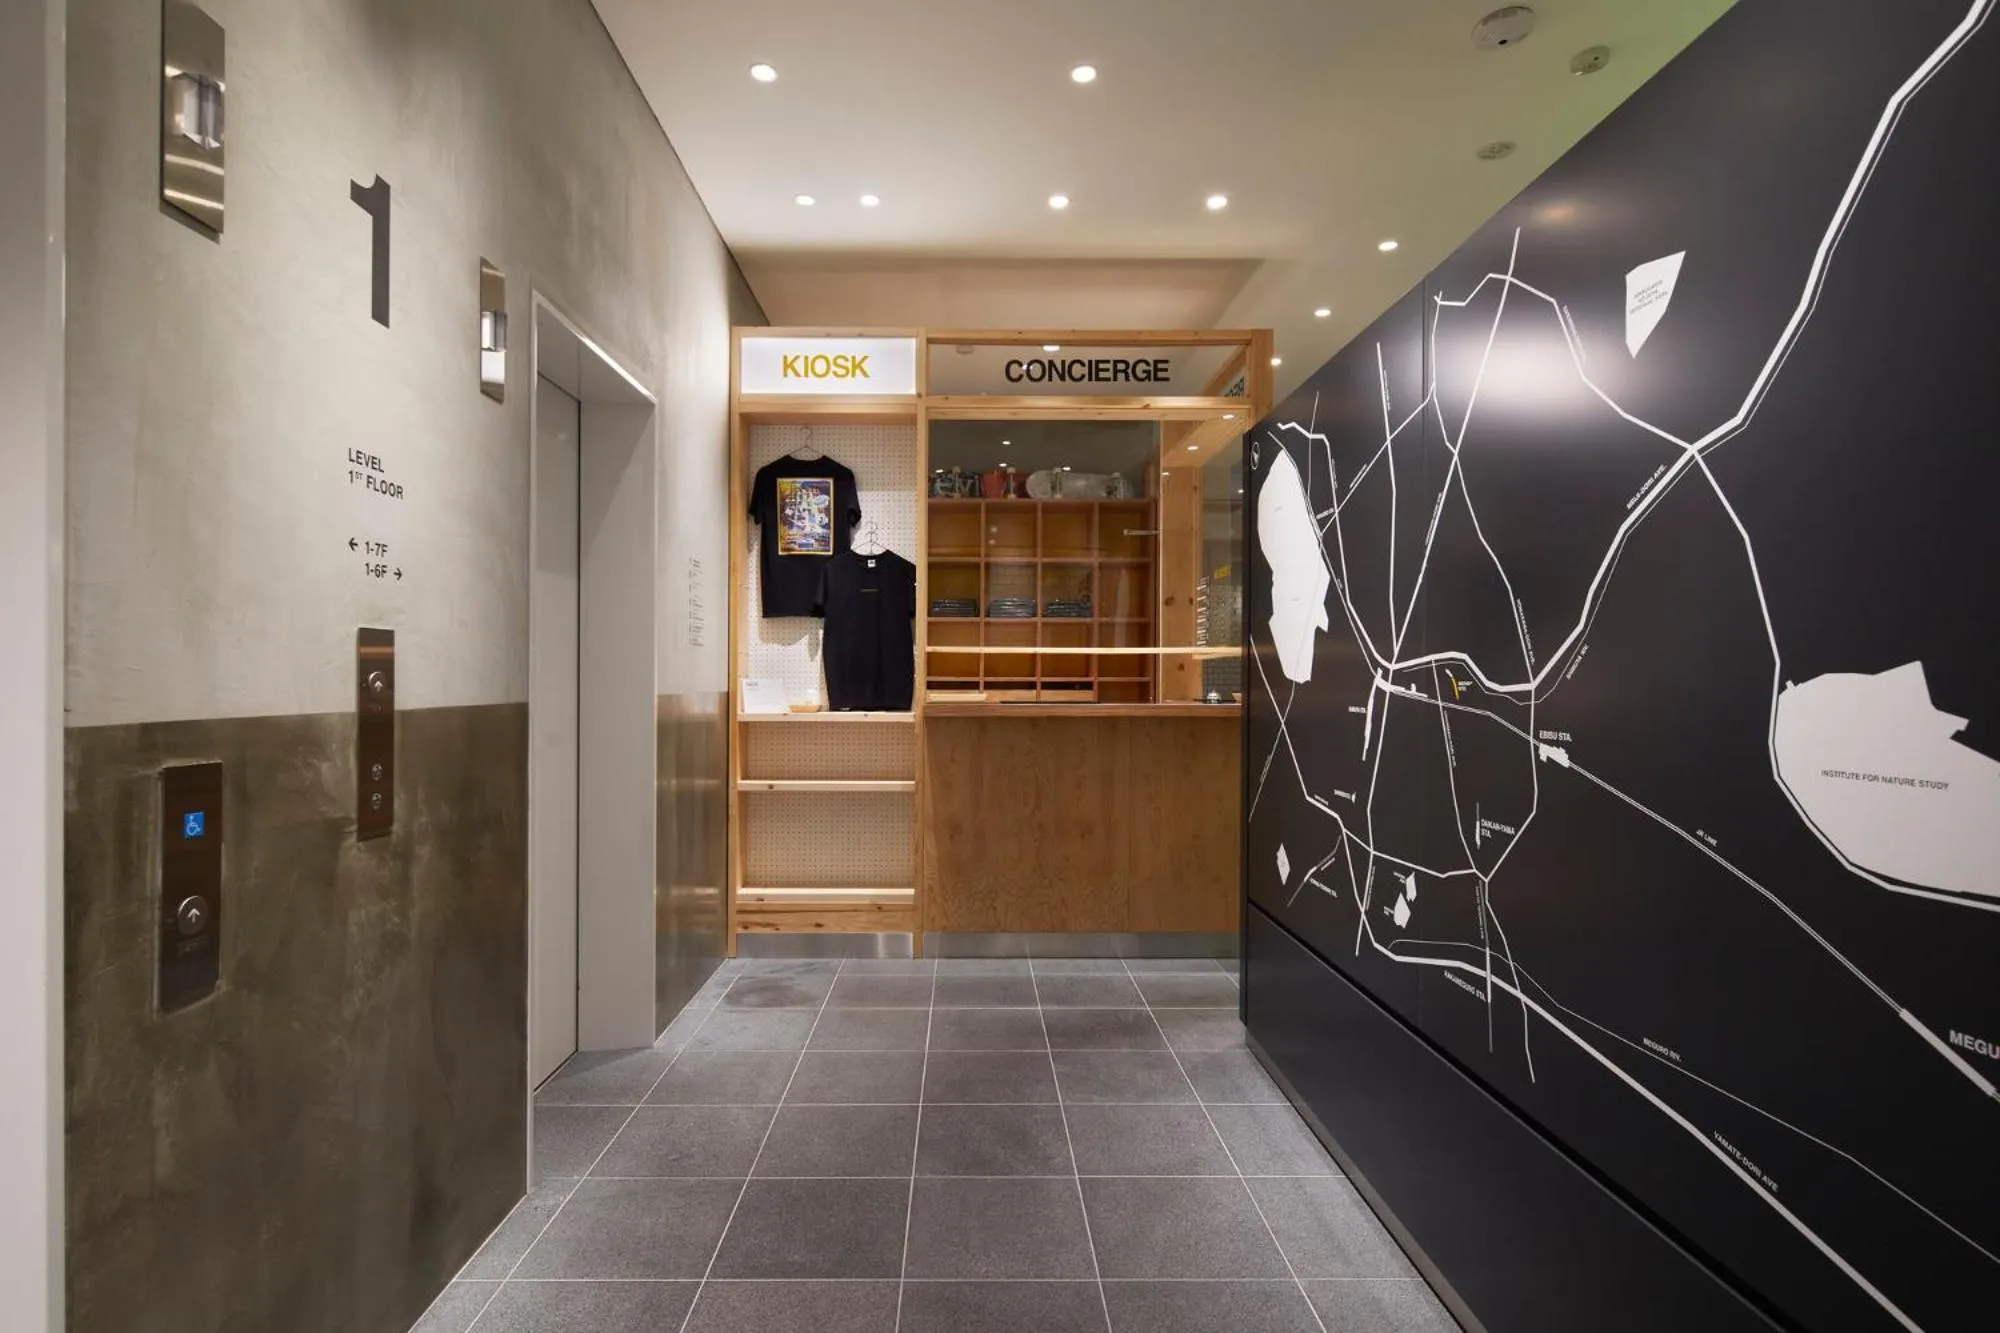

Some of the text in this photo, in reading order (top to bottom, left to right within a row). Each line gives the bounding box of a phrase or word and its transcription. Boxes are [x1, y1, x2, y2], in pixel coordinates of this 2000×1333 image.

[350, 173, 391, 329] 1
[782, 354, 870, 379] KIOSK
[1004, 359, 1170, 383] CONCIERGE
[348, 447, 384, 473] LEVEL
[366, 475, 404, 499] FLOOR
[365, 541, 389, 557] 1-7F
[365, 563, 389, 578] 1-6F
[1821, 769, 1950, 790] INSTITUTE FOR NATURE STUDY
[1949, 1029, 2000, 1059] MEGU
